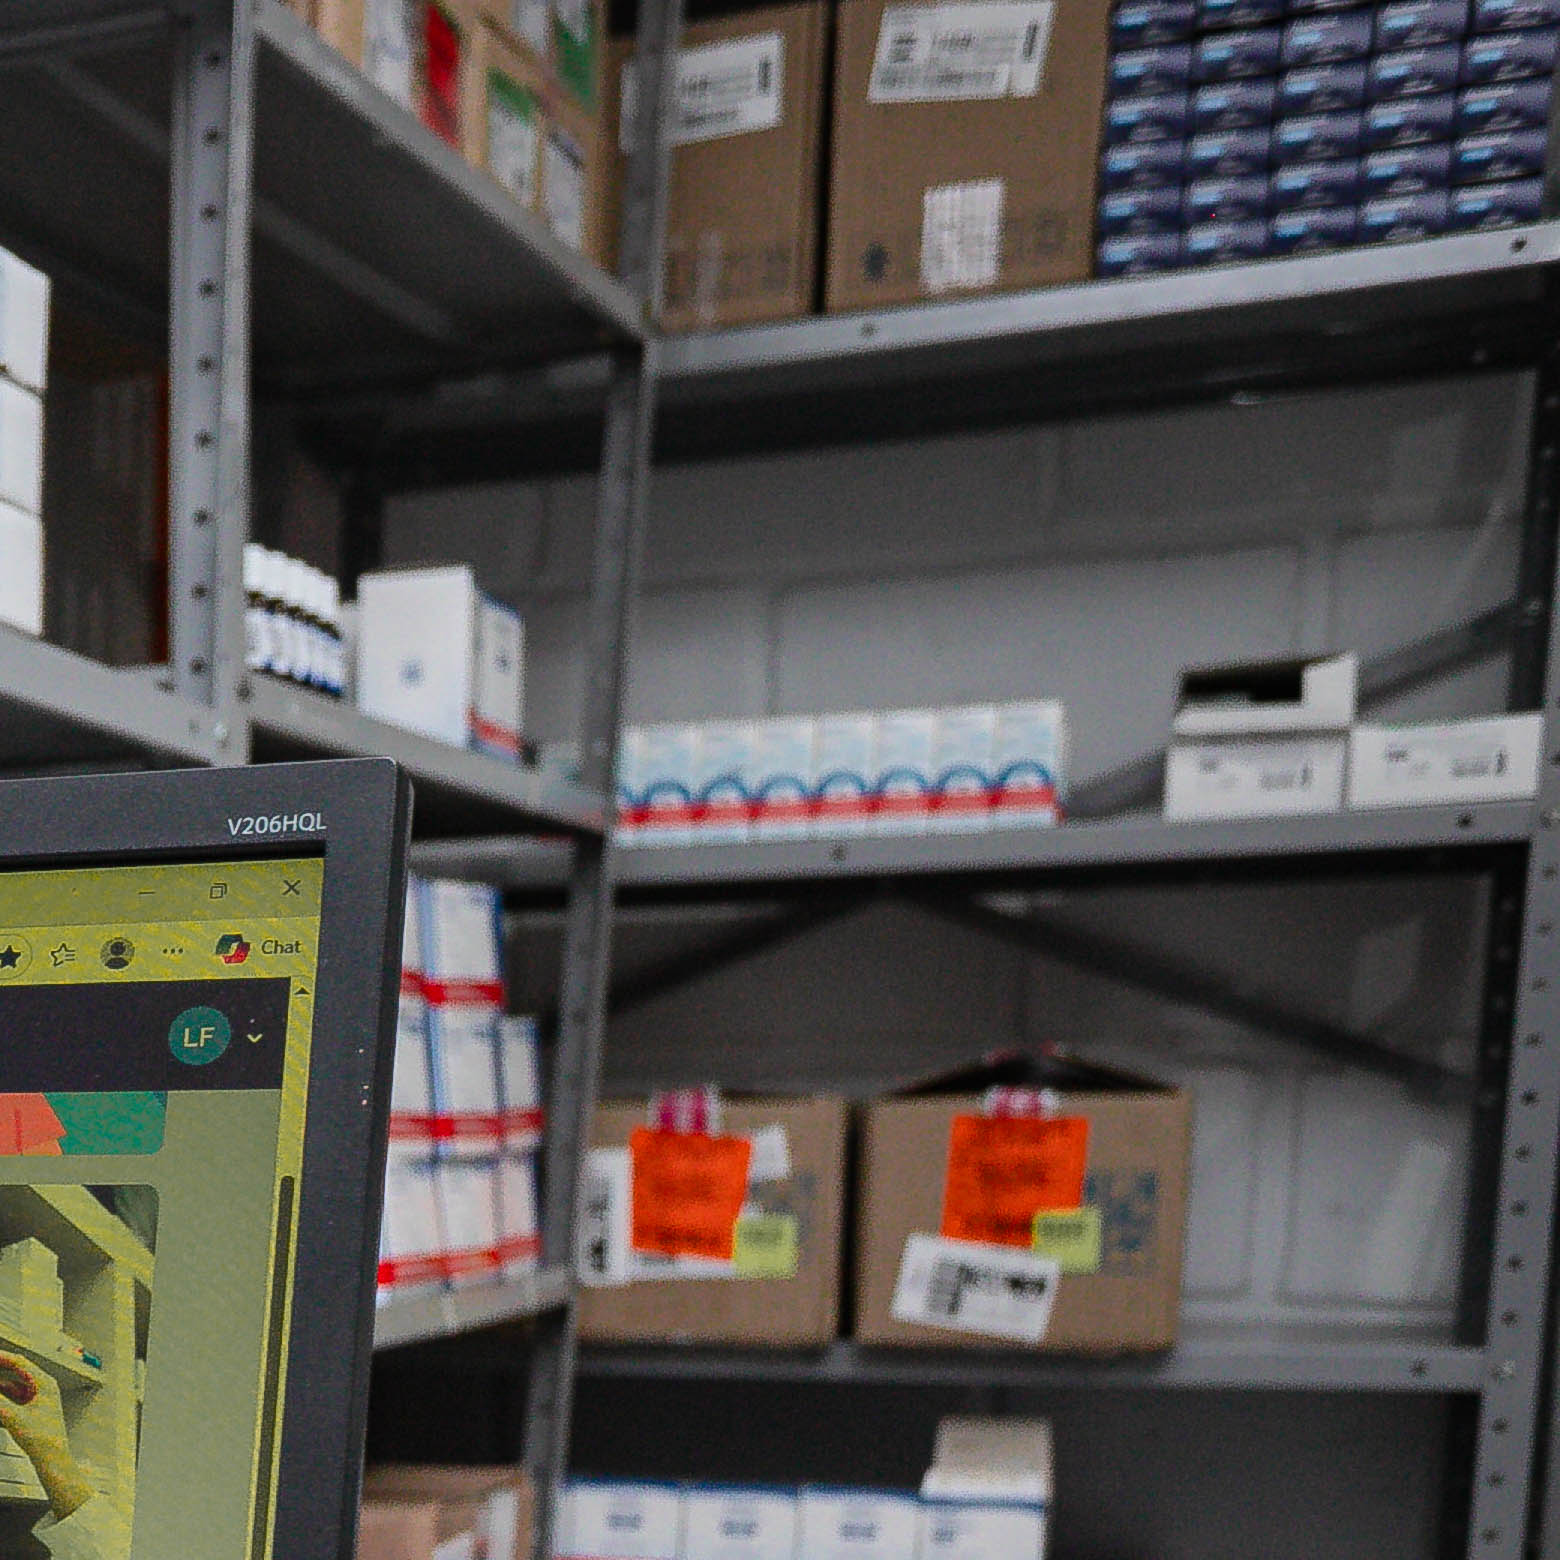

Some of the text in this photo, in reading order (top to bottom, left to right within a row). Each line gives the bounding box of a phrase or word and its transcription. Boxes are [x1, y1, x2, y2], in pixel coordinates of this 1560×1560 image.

[228, 812, 327, 836] V206HQL
[261, 938, 301, 956] Chat
[183, 1027, 216, 1049] LF
